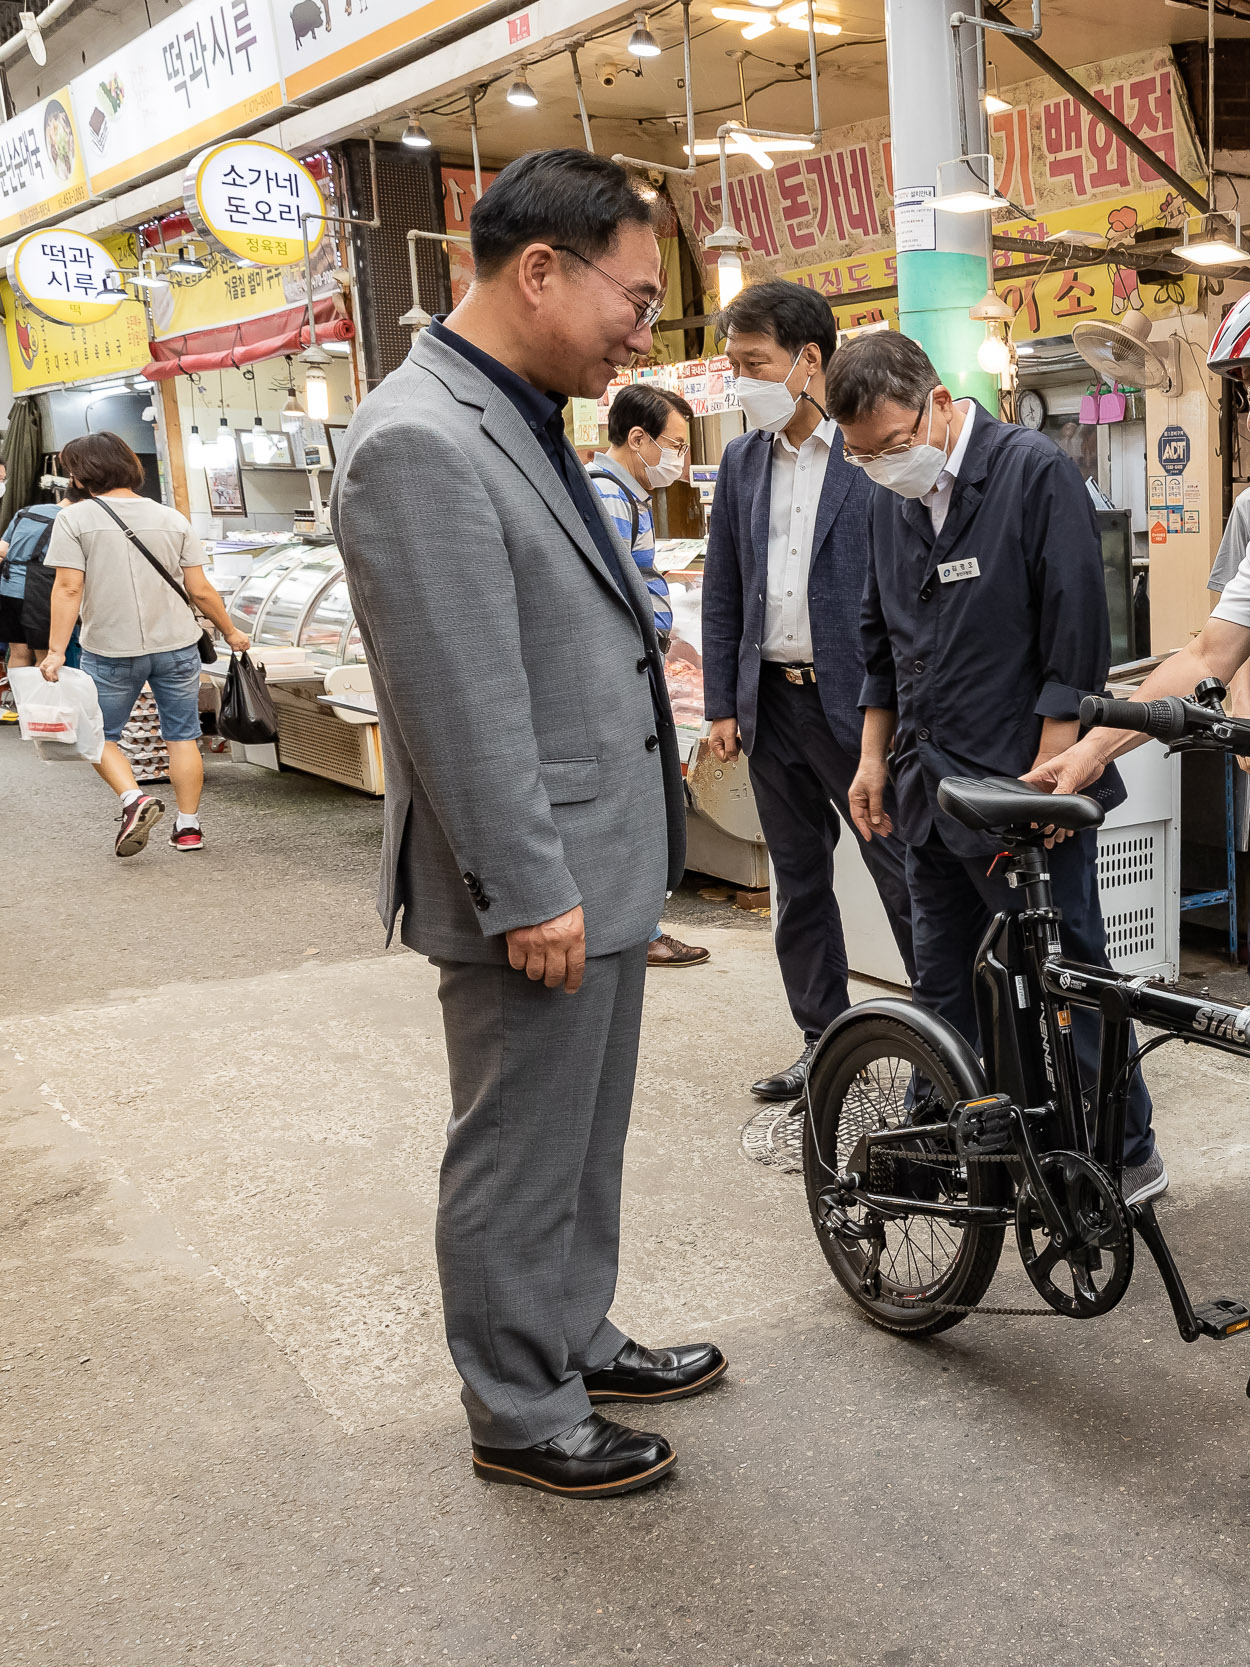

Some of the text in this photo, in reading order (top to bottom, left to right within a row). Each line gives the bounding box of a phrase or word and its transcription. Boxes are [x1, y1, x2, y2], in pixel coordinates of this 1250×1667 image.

[162, 0, 257, 109] 떡과시루
[221, 165, 301, 198] 소가네
[775, 147, 879, 250] 돈가네
[224, 197, 303, 229] 돈오리
[41, 244, 94, 269] 떡과
[246, 237, 288, 257] 정육점
[48, 271, 98, 296] 시루
[69, 303, 82, 316] 떡
[1162, 441, 1186, 460] ADT
